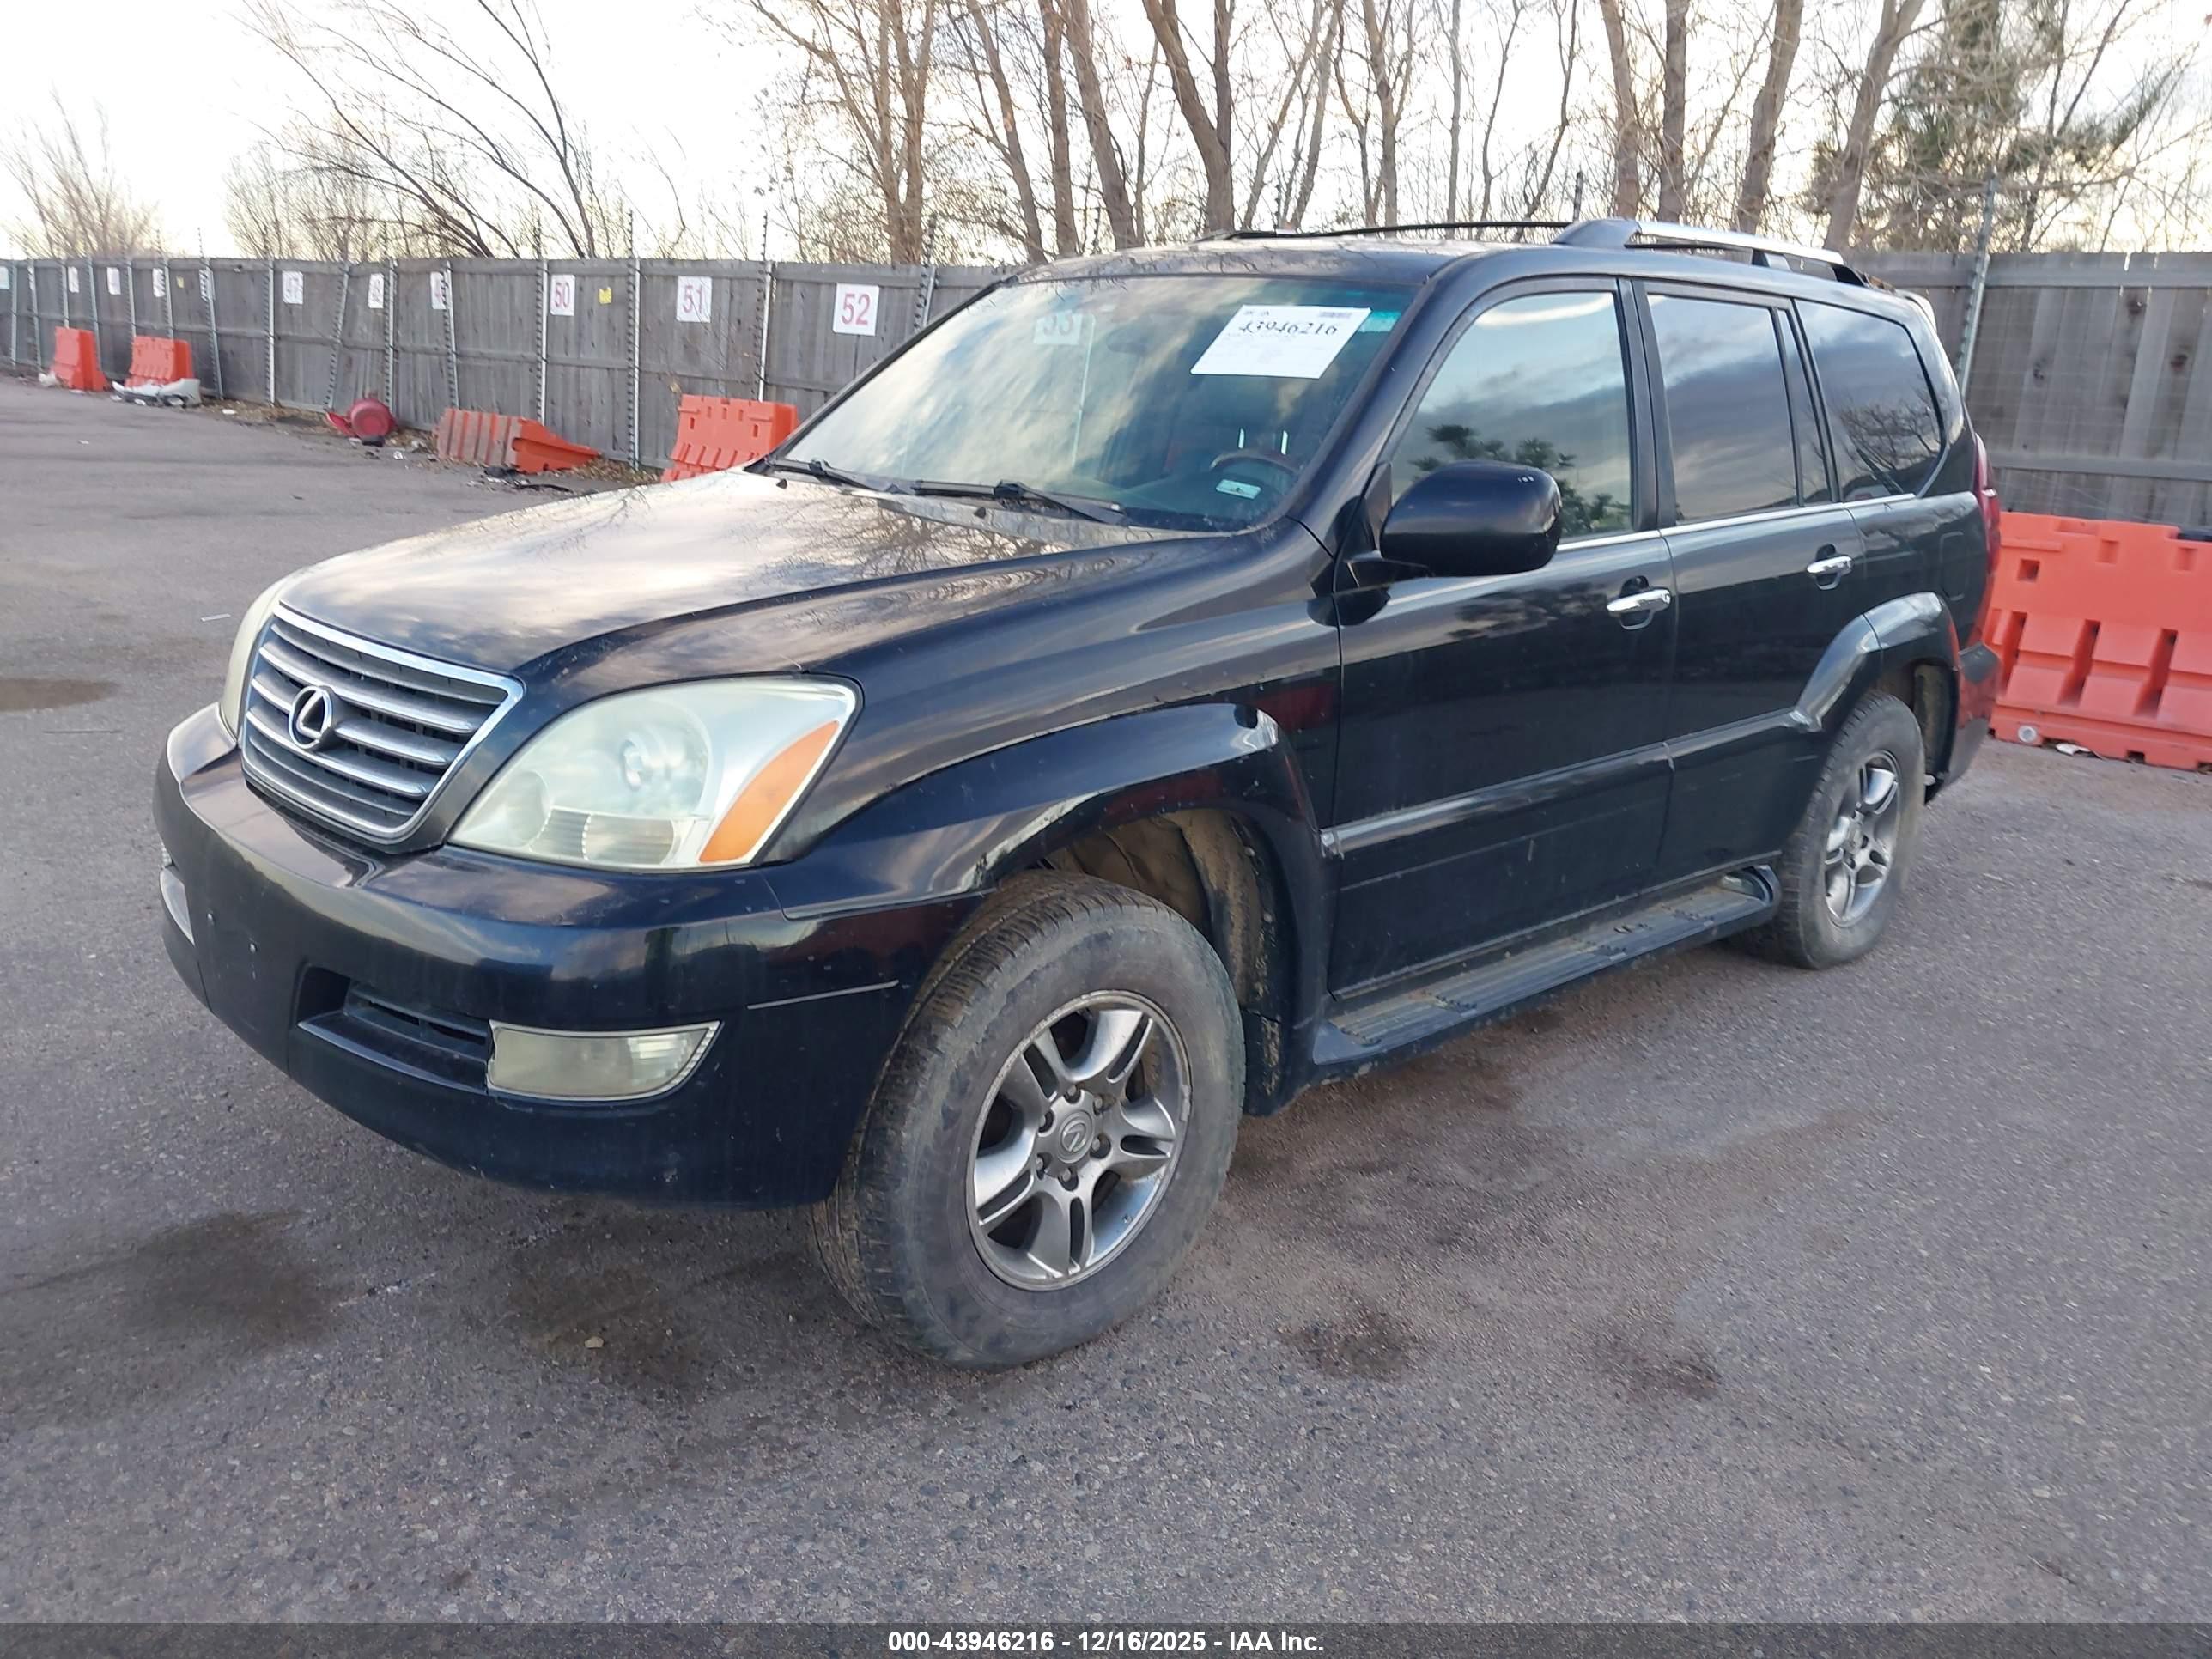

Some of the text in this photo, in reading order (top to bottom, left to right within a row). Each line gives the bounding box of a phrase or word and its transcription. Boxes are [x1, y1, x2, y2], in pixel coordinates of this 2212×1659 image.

[554, 282, 570, 308] 50
[683, 285, 702, 313] 51
[842, 293, 871, 325] 52
